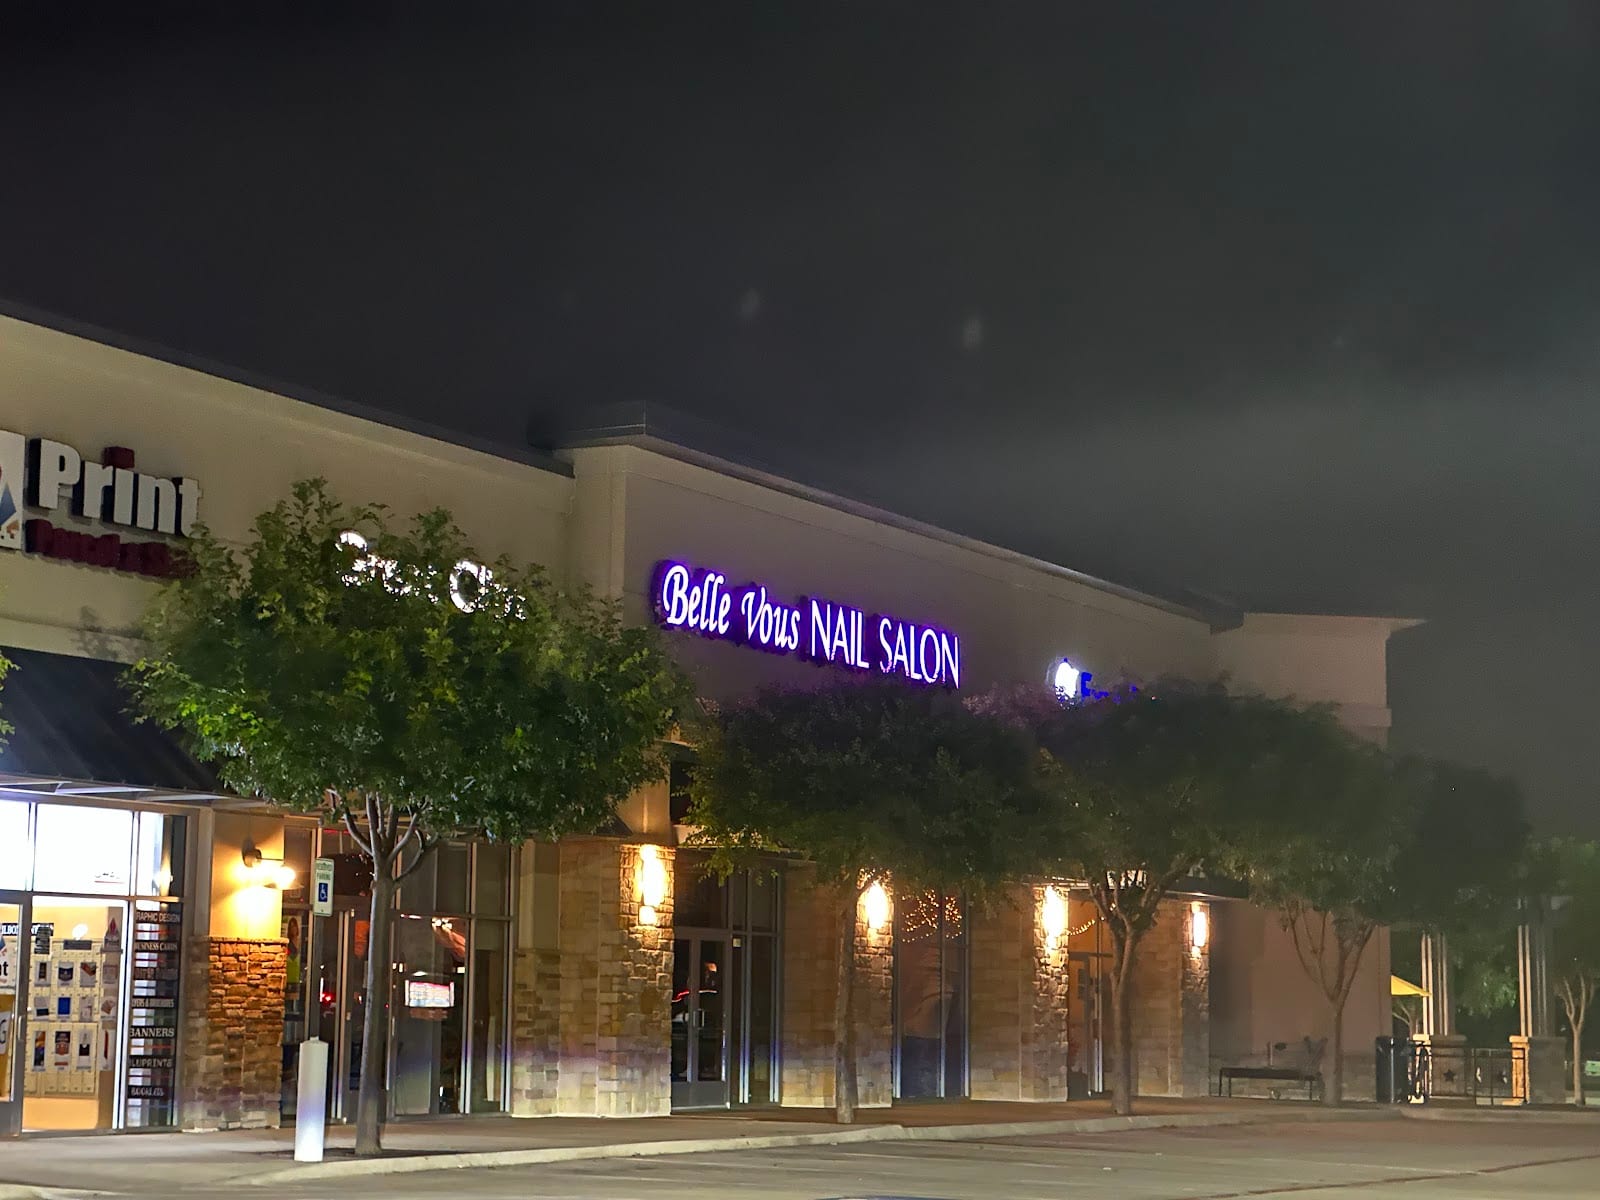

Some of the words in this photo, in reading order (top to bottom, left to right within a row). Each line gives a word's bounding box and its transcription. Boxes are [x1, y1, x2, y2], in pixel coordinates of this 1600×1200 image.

[38, 438, 201, 539] Print
[662, 564, 732, 635] Belle
[740, 586, 801, 650] Vous
[810, 599, 870, 669] NAIL
[878, 617, 960, 689] SALON
[129, 1026, 176, 1038] BANNERS
